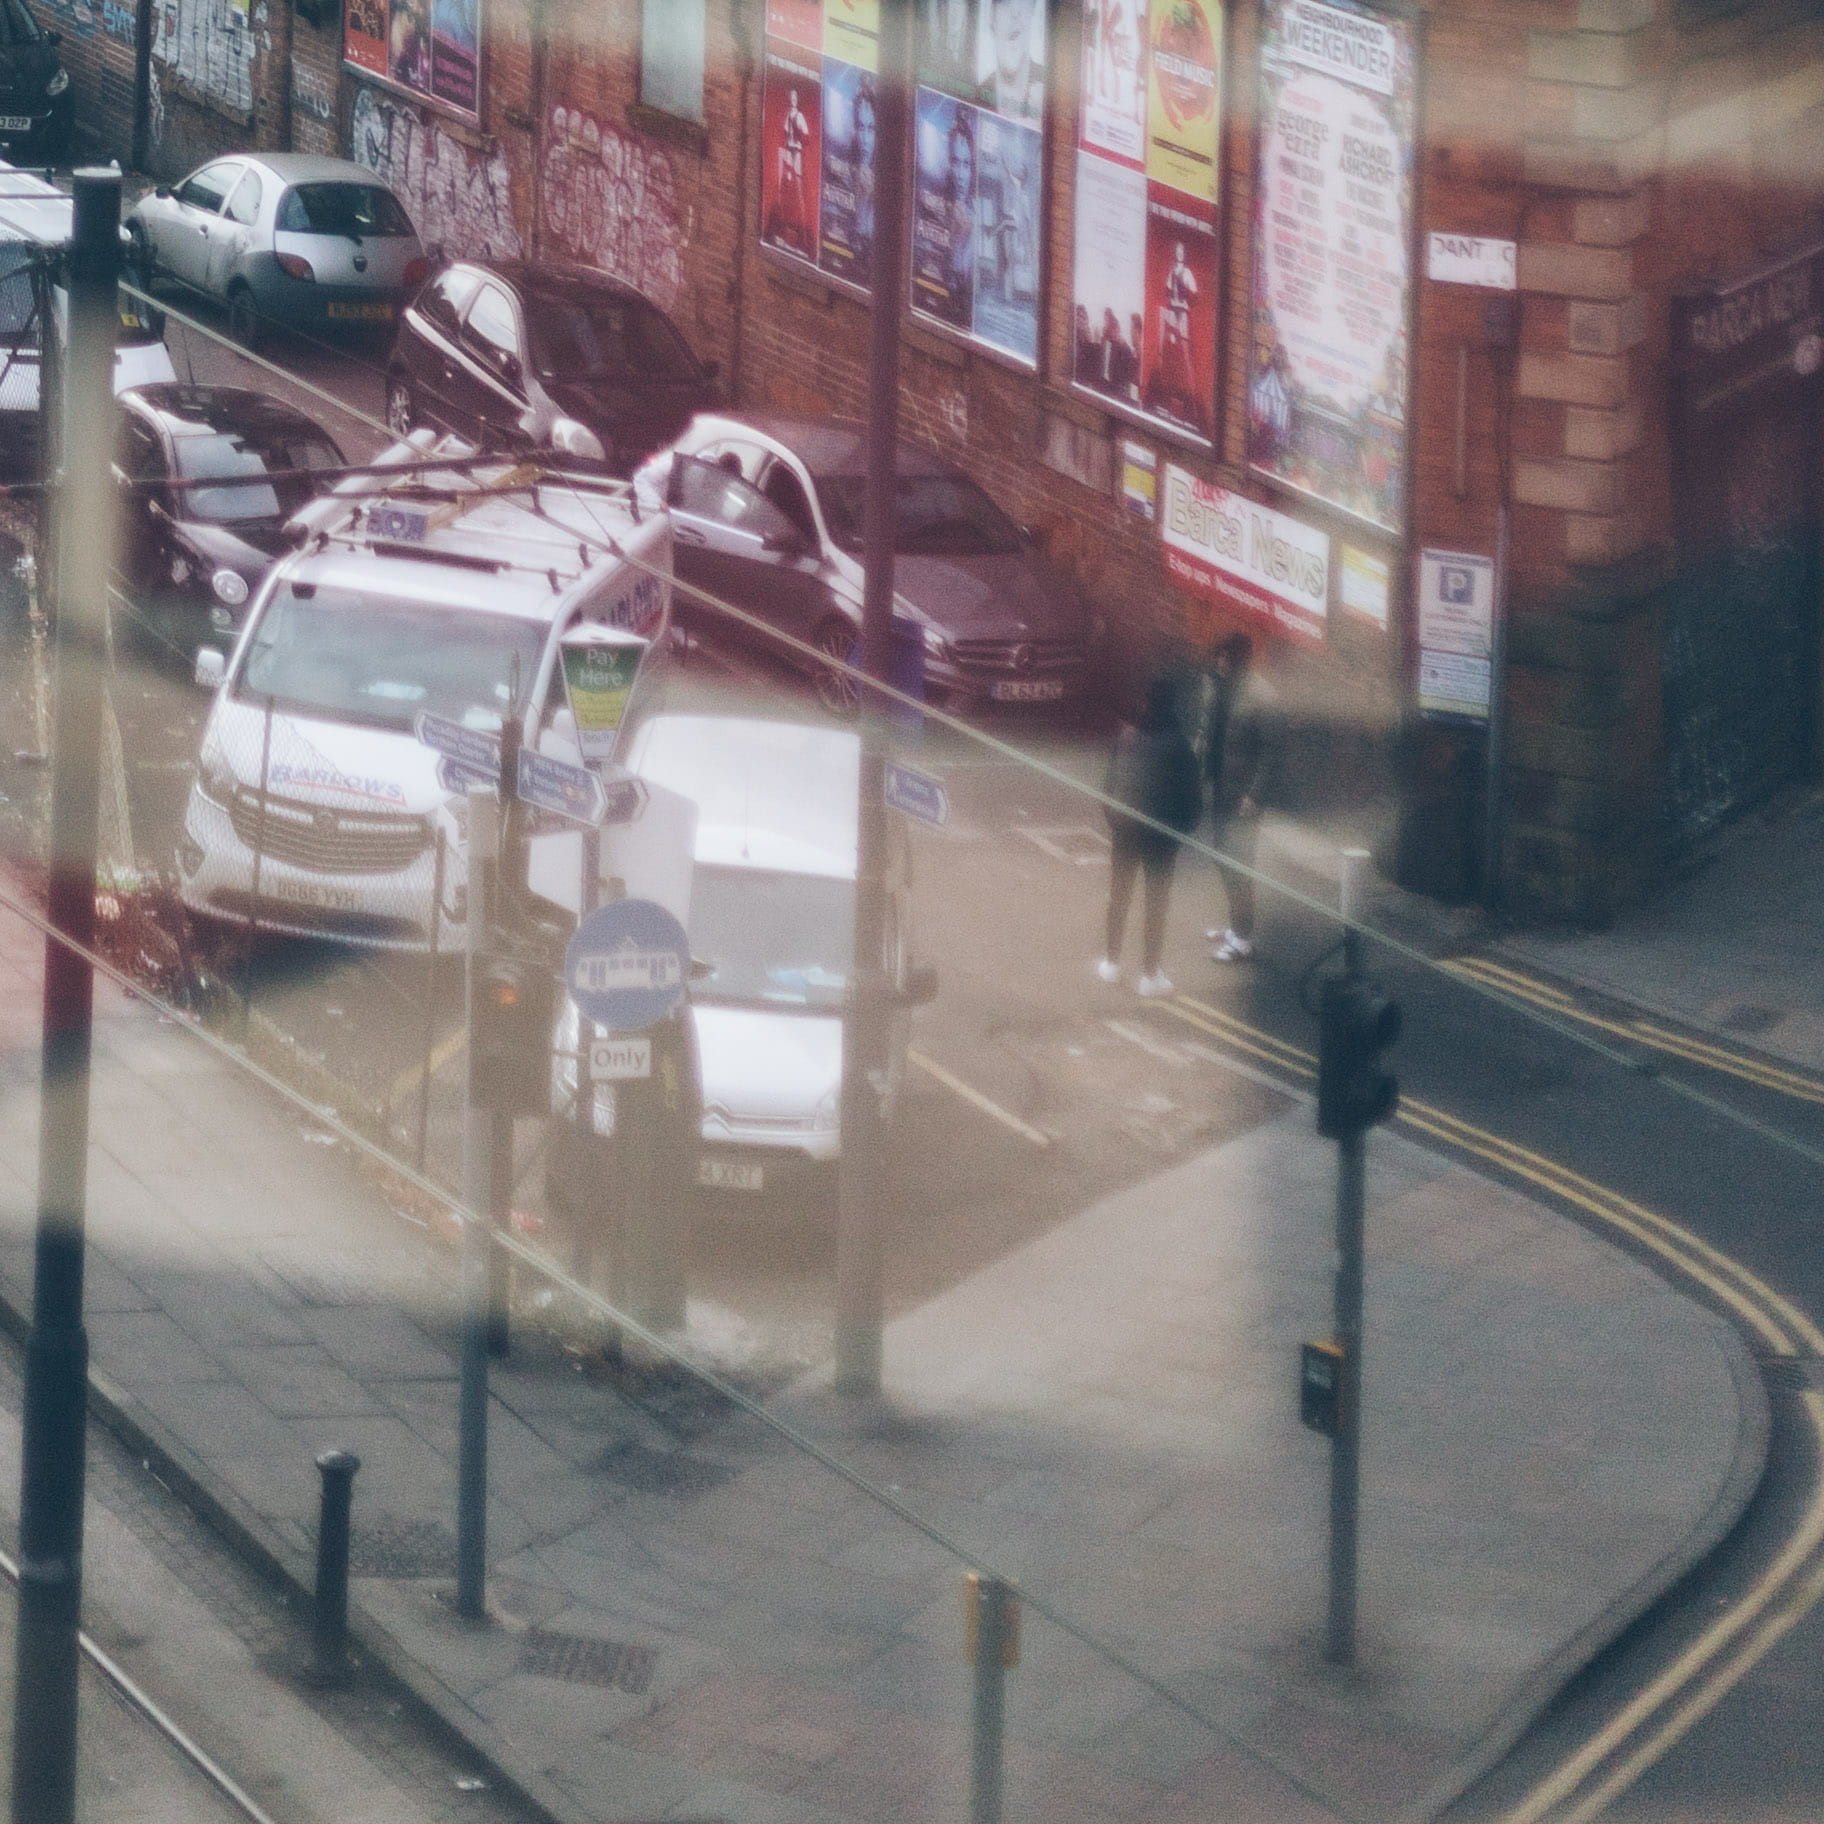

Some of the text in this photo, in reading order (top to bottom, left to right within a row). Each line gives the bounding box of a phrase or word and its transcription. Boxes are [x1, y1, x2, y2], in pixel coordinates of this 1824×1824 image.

[1286, 19, 1391, 81] WEEKENDER
[1342, 133, 1392, 168] RICHARD
[1250, 513, 1326, 600] News
[586, 648, 619, 670] Pay
[580, 670, 623, 688] Here
[594, 1050, 646, 1071] Only
